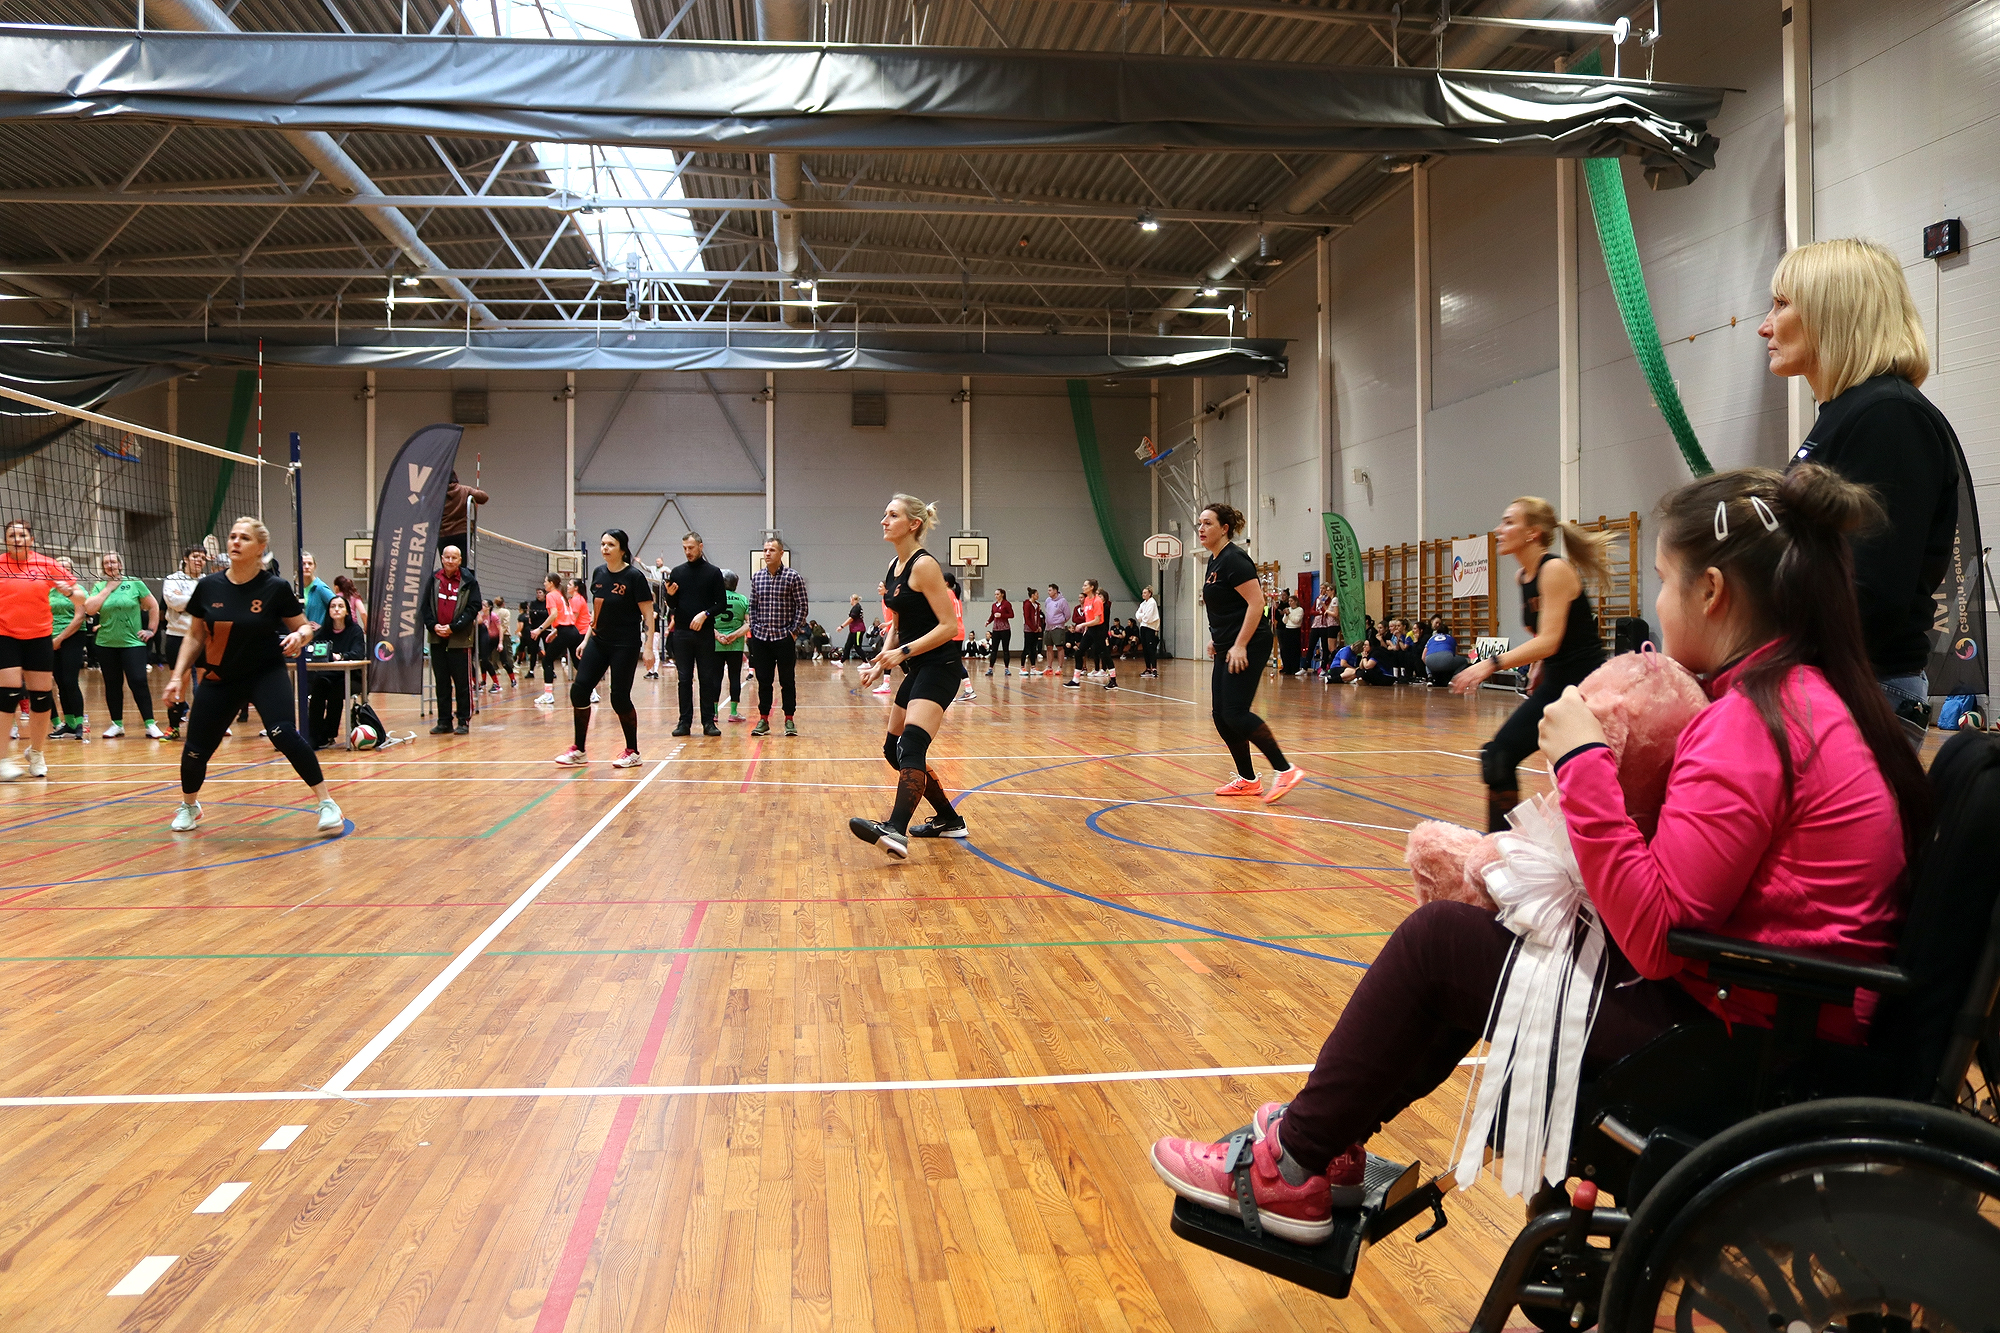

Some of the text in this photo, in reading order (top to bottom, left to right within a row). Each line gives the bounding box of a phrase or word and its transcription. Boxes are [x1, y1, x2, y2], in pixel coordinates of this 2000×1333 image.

[381, 527, 403, 637] Catch'n Serve BALL
[399, 521, 429, 638] VALMIERA
[120, 584, 131, 592] 99
[611, 583, 627, 596] 28
[250, 599, 263, 614] 8
[720, 604, 734, 622] 5
[314, 643, 328, 656] 5
